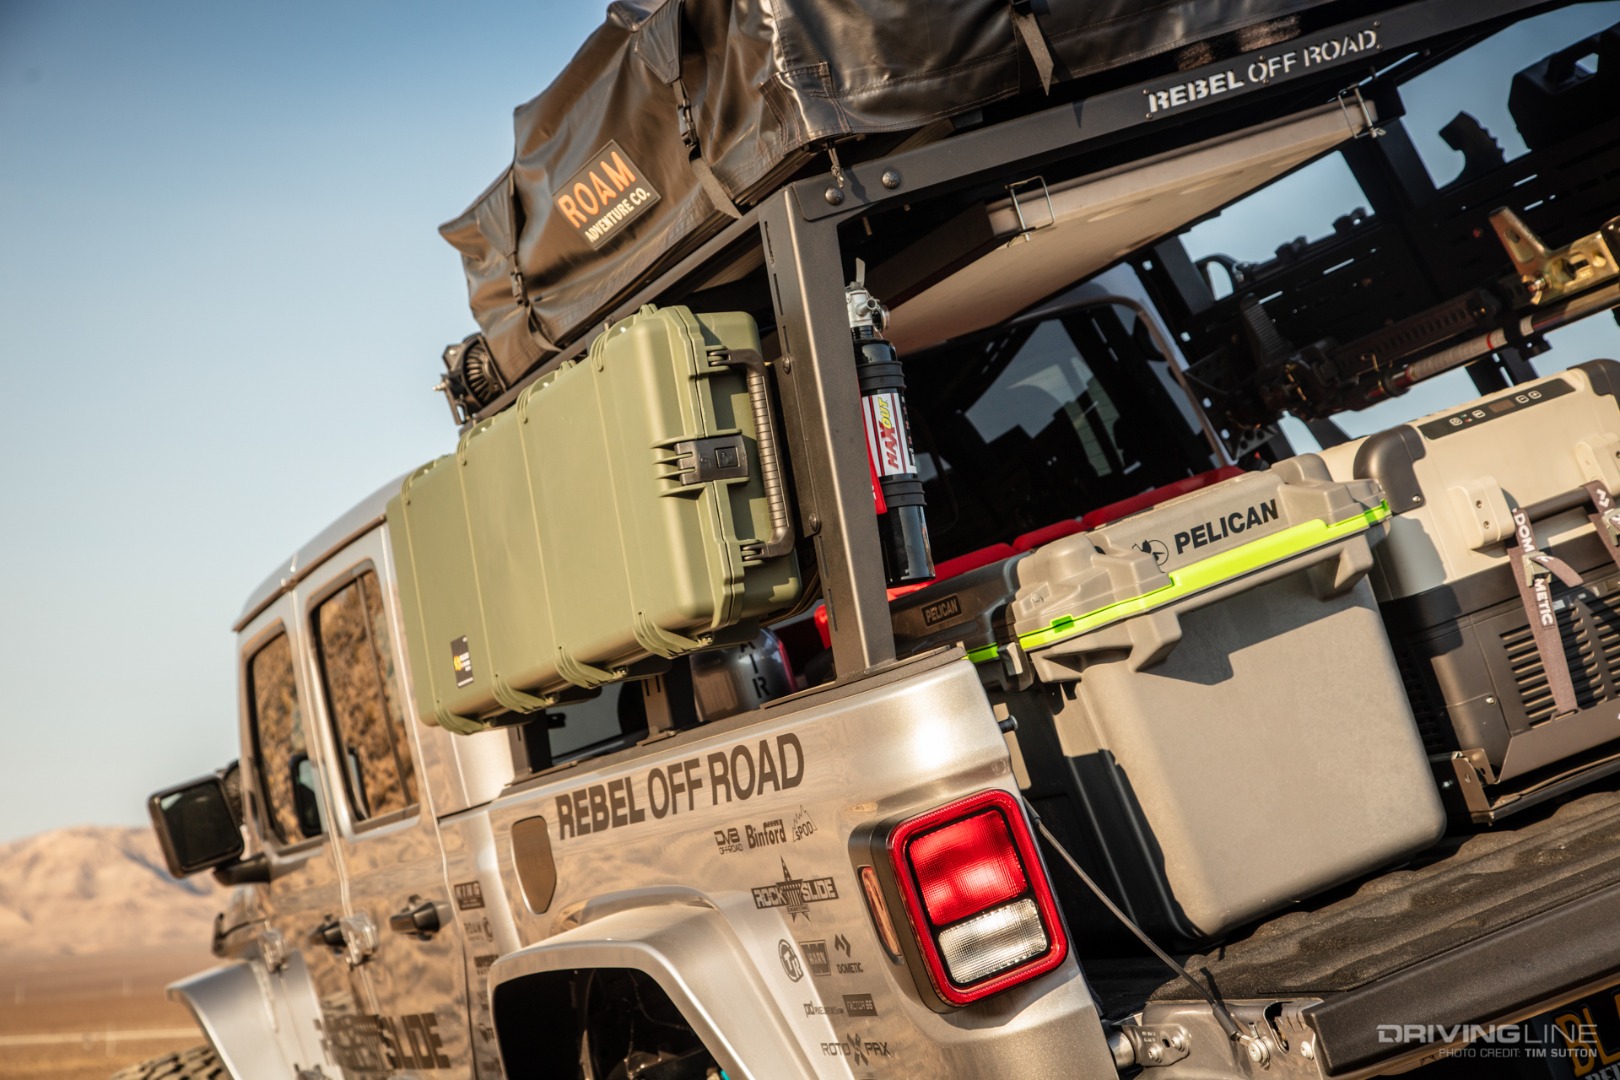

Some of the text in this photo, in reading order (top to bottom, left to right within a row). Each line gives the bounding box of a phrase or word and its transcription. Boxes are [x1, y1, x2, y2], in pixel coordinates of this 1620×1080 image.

[1149, 30, 1377, 113] REBEL OFF ROAD
[558, 151, 636, 229] ROAM
[585, 187, 651, 243] ADVENTURE CO.
[1174, 499, 1279, 555] PELICAN
[925, 598, 960, 623] PELICAN
[555, 732, 804, 840] REBEL OFF ROAD
[745, 819, 787, 849] Binford
[754, 878, 837, 908] ROCK SLIDE
[837, 962, 864, 974] DOMETIC
[820, 1042, 851, 1056] ROTO
